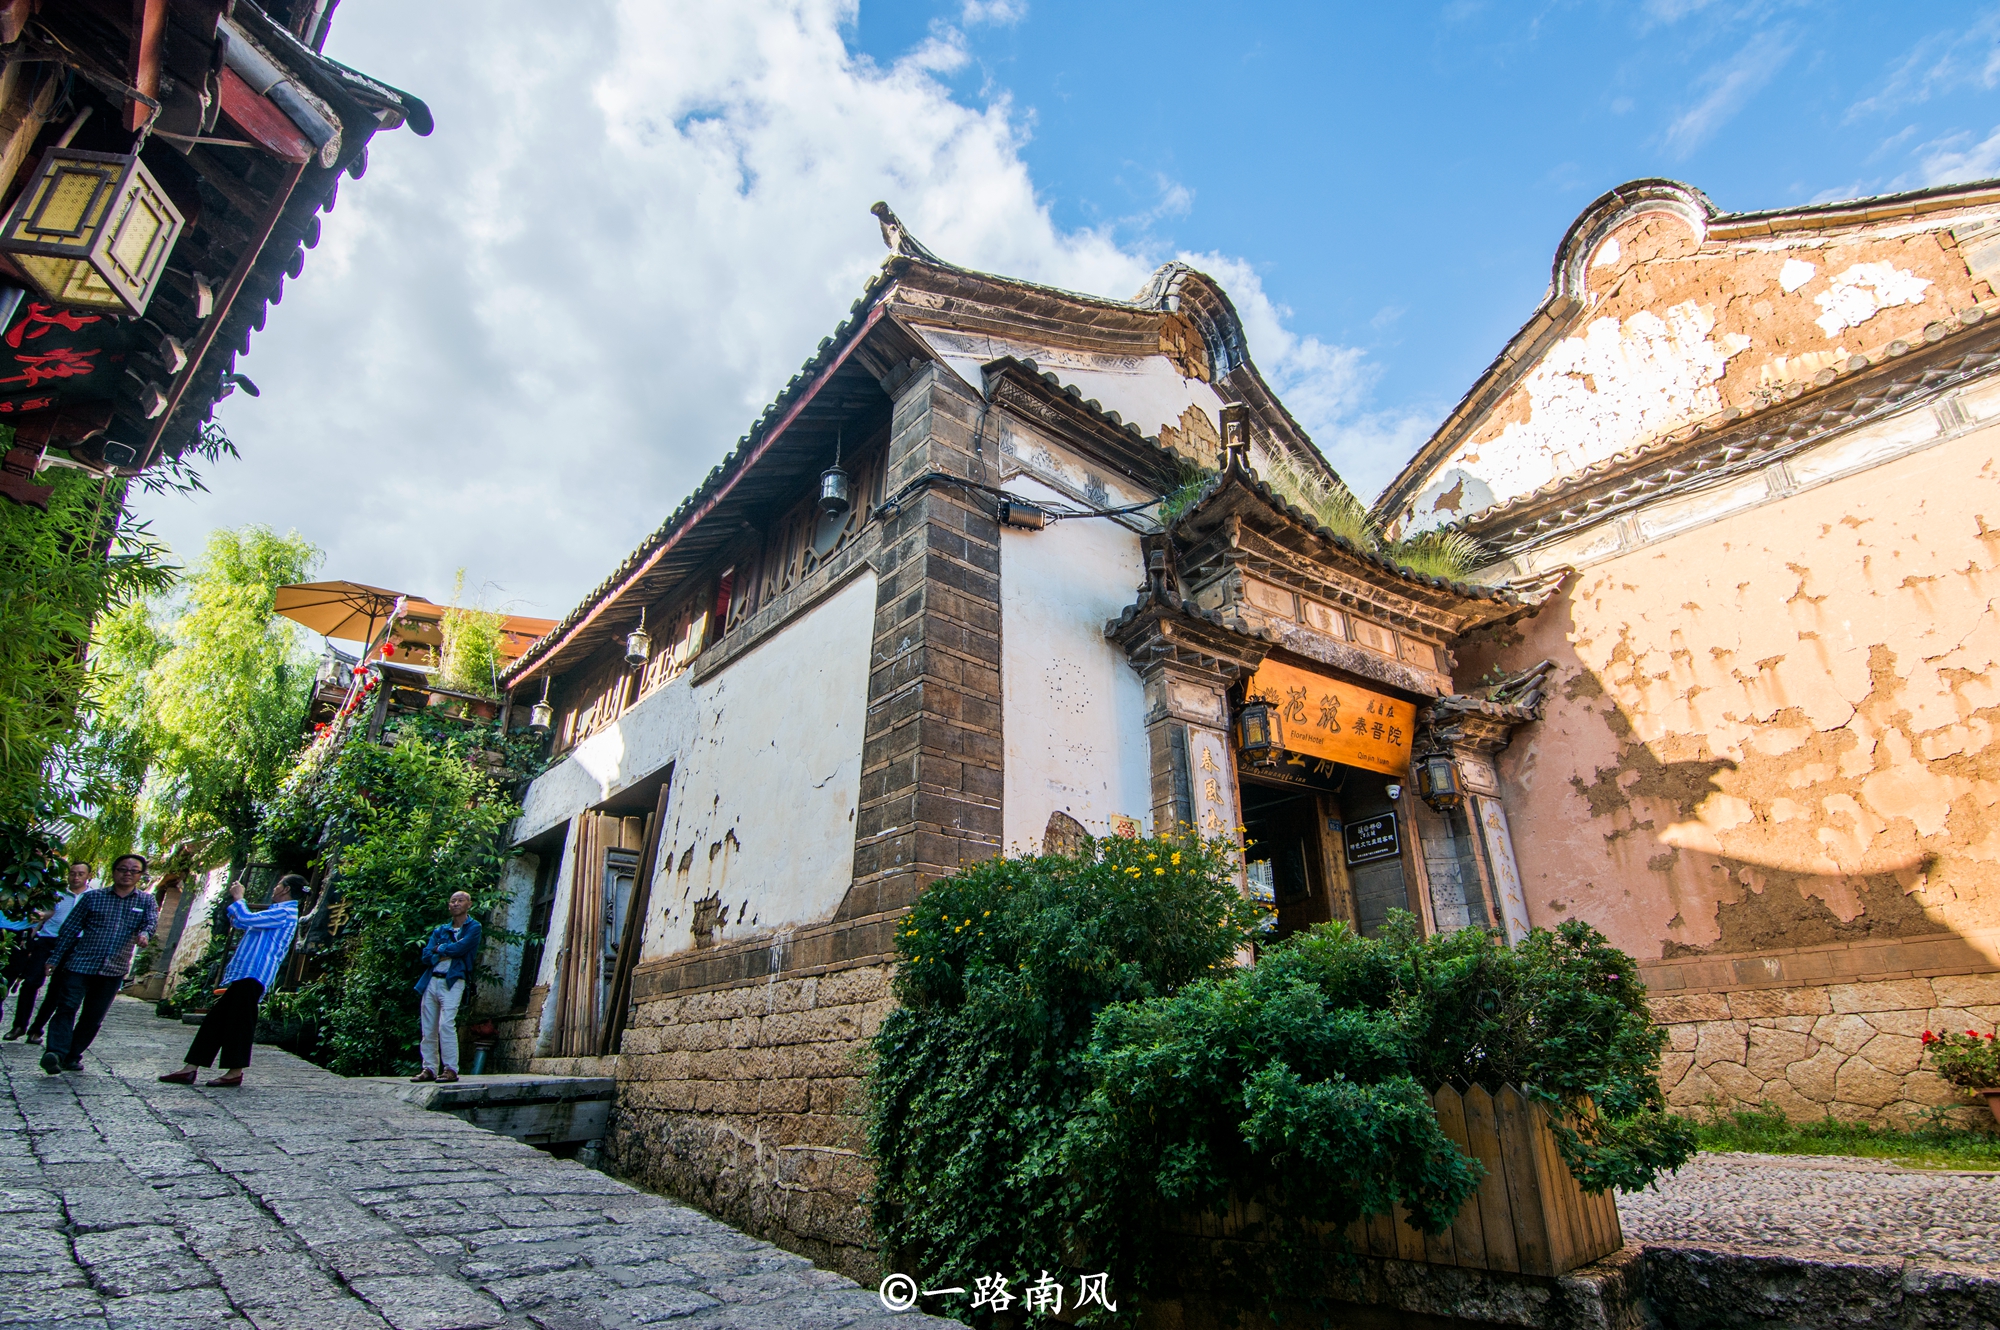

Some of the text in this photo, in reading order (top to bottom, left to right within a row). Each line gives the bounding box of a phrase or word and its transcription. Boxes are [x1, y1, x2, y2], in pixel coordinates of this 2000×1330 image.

[1290, 730, 1324, 745] Floral Hotel
[1352, 717, 1402, 747] 秦晋院
